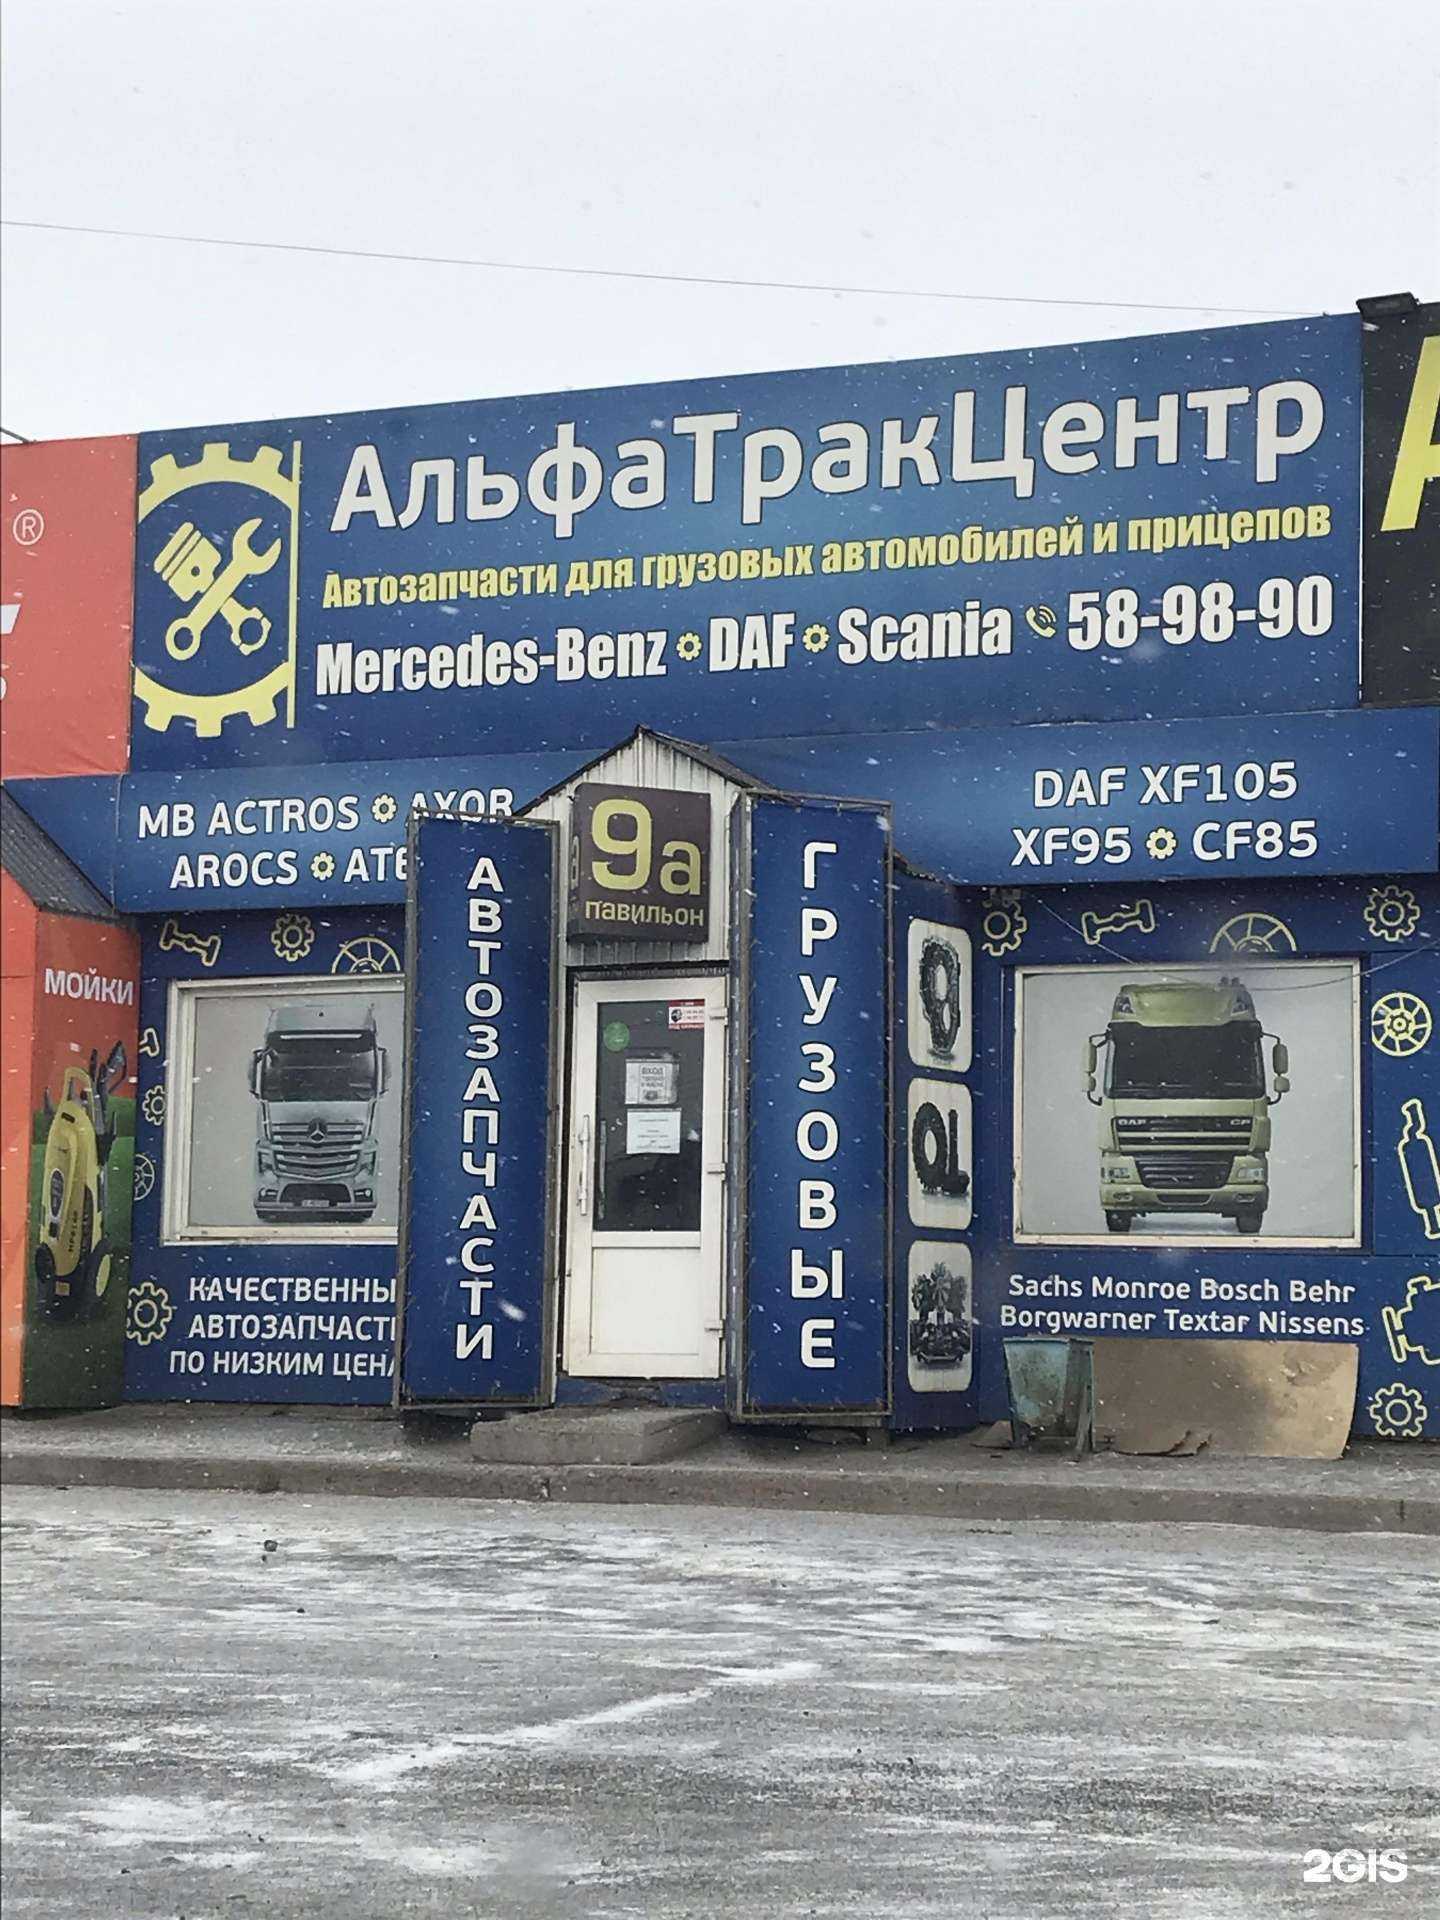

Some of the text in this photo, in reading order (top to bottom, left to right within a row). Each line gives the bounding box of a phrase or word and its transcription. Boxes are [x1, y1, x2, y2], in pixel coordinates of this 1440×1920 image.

[330, 379, 1325, 538] АльфаТракЦентр
[322, 504, 1332, 608] Автозапчасти для грузовых автомобилей и прицепов
[316, 575, 1333, 696] Mercedes-Benz DAF Scania 58-98-90
[1034, 760, 1299, 808] DAF XF105
[138, 804, 195, 839] MB
[207, 796, 360, 836] ACTROS
[1011, 820, 1318, 867] XF95 CF85
[170, 850, 299, 889] AROCS
[585, 900, 704, 926] павильон
[44, 966, 134, 1006] МОЙКИ
[1008, 1274, 1355, 1303] Sachs Monroe Bosch Behr
[1000, 1304, 1365, 1336] Borgwarner Textar Nissens
[169, 1350, 205, 1374] ПО
[213, 1351, 324, 1375] НИЗКИМ
